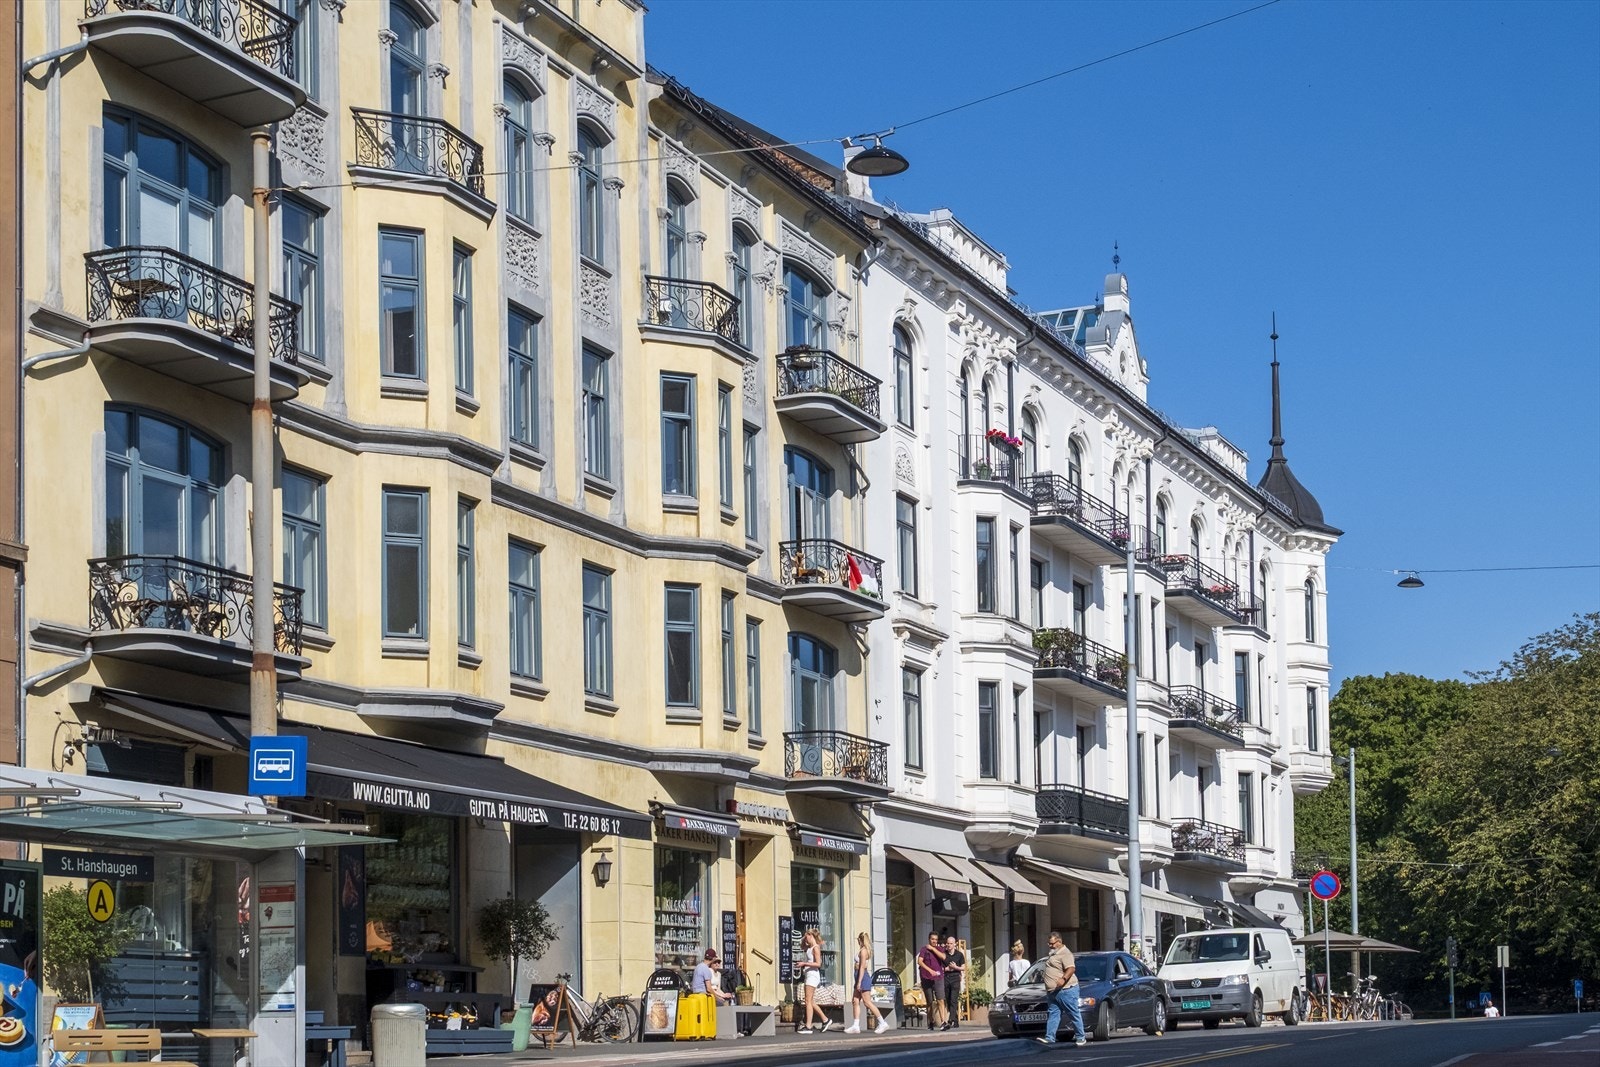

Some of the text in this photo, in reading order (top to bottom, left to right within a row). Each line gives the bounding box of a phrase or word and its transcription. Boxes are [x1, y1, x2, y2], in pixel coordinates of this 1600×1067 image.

[353, 782, 430, 810] WWW.GUTTA.NO
[469, 799, 549, 823] GUTTA PÅ HAUGEN
[563, 812, 621, 835] TLF. 22 60 85 12
[686, 818, 706, 831] BAKER
[706, 821, 728, 835] HANSEN
[796, 846, 845, 862] BAKER HANSEN
[821, 838, 836, 849] BAKER
[836, 840, 855, 852] HANSEN
[61, 856, 138, 877] St. Hanshaugen
[3, 880, 26, 919] PÅ
[95, 889, 108, 914] A
